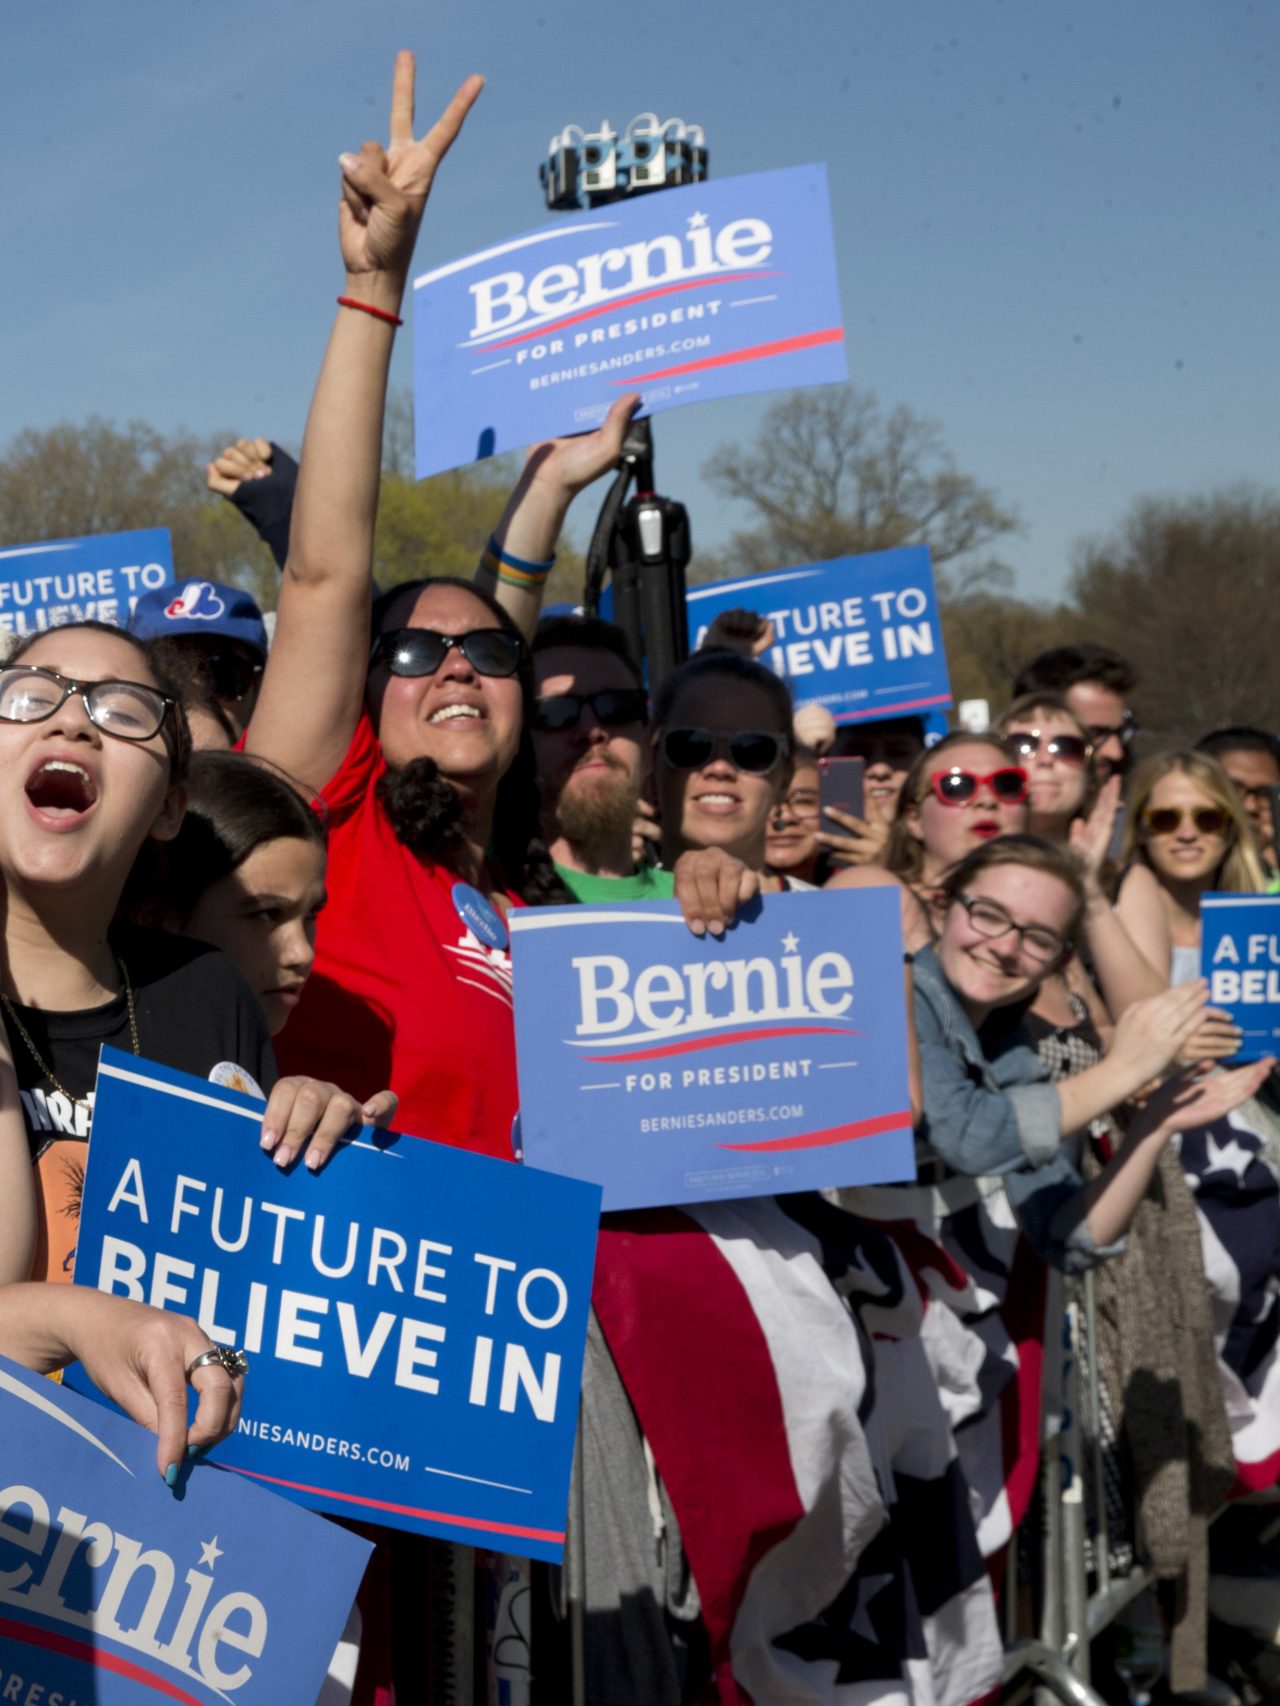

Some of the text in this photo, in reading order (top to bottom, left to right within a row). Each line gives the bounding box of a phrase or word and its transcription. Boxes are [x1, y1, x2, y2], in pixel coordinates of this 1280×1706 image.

[468, 210, 773, 339] Bernie
[516, 300, 722, 365] FOR PRESIDENT
[530, 335, 711, 391] BERNIESANDERS.COM
[121, 563, 166, 591] TO
[767, 587, 927, 639] TURE TO
[771, 622, 934, 678] IEVE IN
[1213, 934, 1240, 964] A
[572, 930, 854, 1036] Bernie
[625, 1059, 812, 1092] FOR PRESIDENT
[640, 1105, 804, 1133] BERNIESANDERS.COM
[107, 1158, 568, 1330] A FUTURE TO
[468, 1335, 561, 1424] IN
[238, 1416, 410, 1472] NIESANDERS.COM
